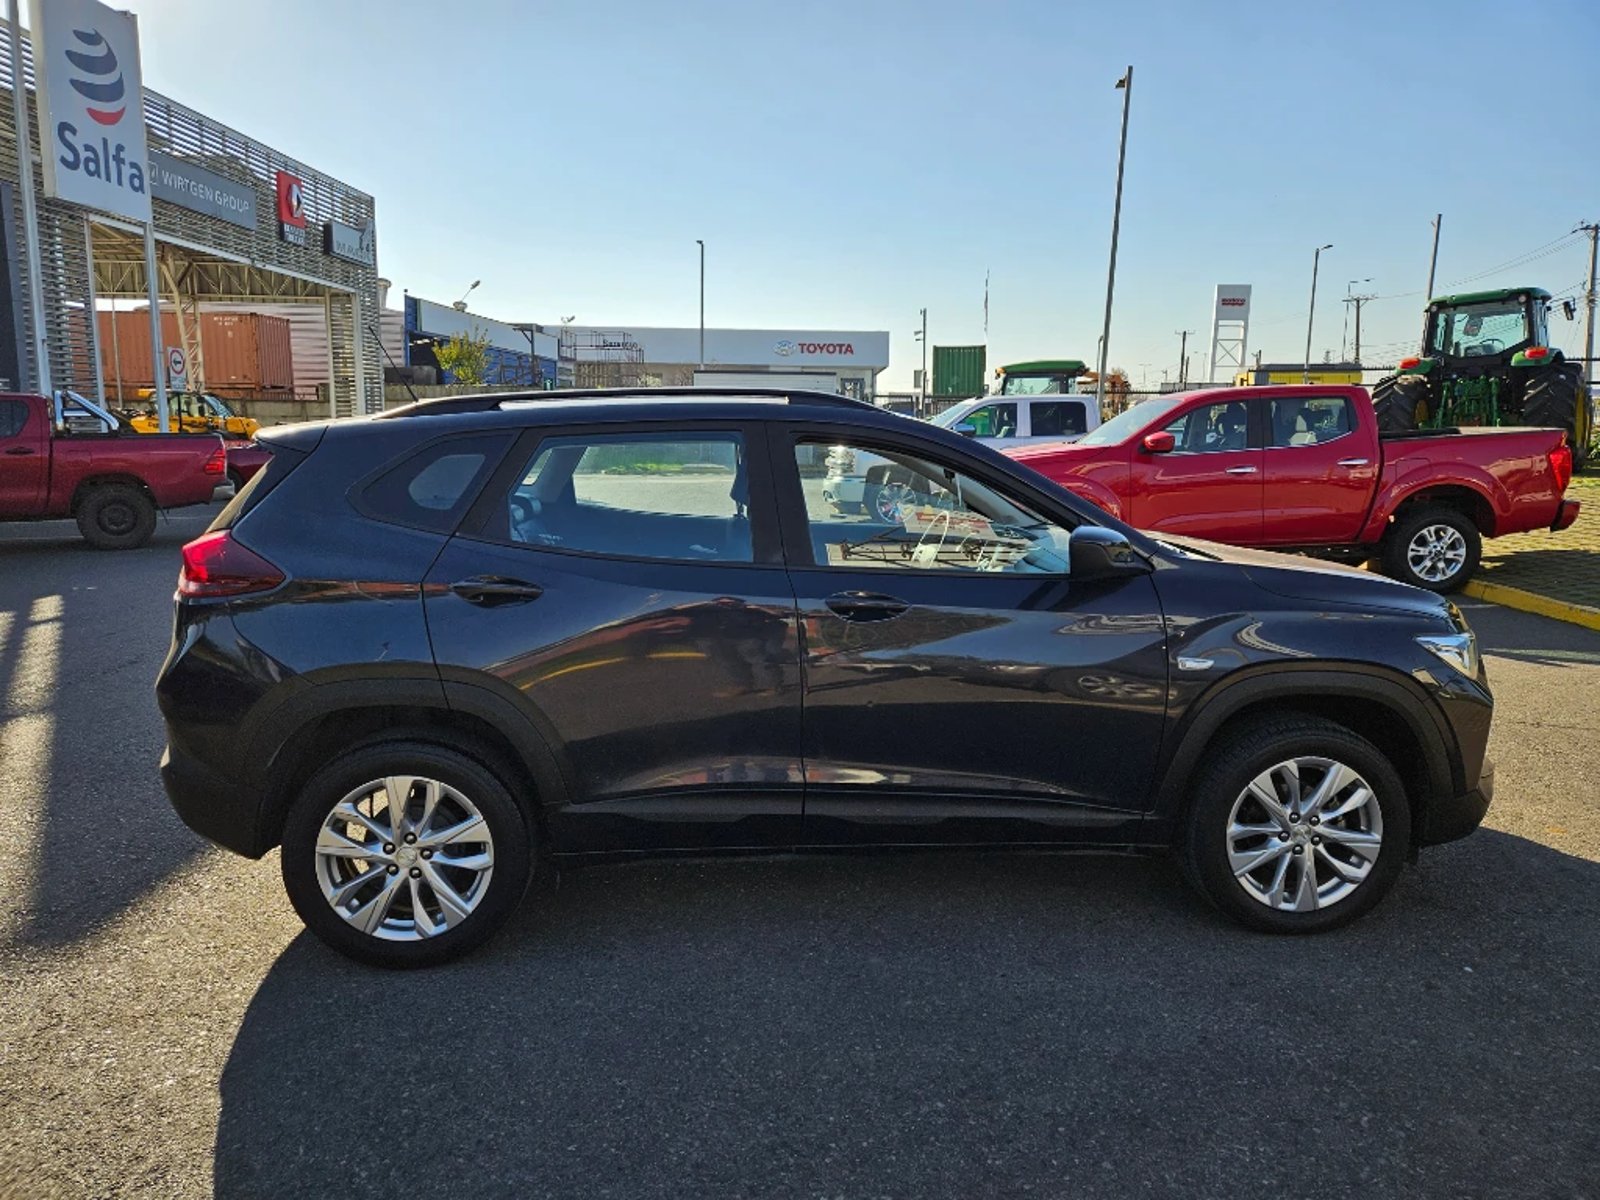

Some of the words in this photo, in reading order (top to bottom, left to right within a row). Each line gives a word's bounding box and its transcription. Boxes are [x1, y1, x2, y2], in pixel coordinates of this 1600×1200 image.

[57, 121, 145, 195] Salfa
[162, 169, 213, 202] WIRTGEN
[215, 190, 249, 213] GROUP
[798, 343, 854, 355] TOYOTA
